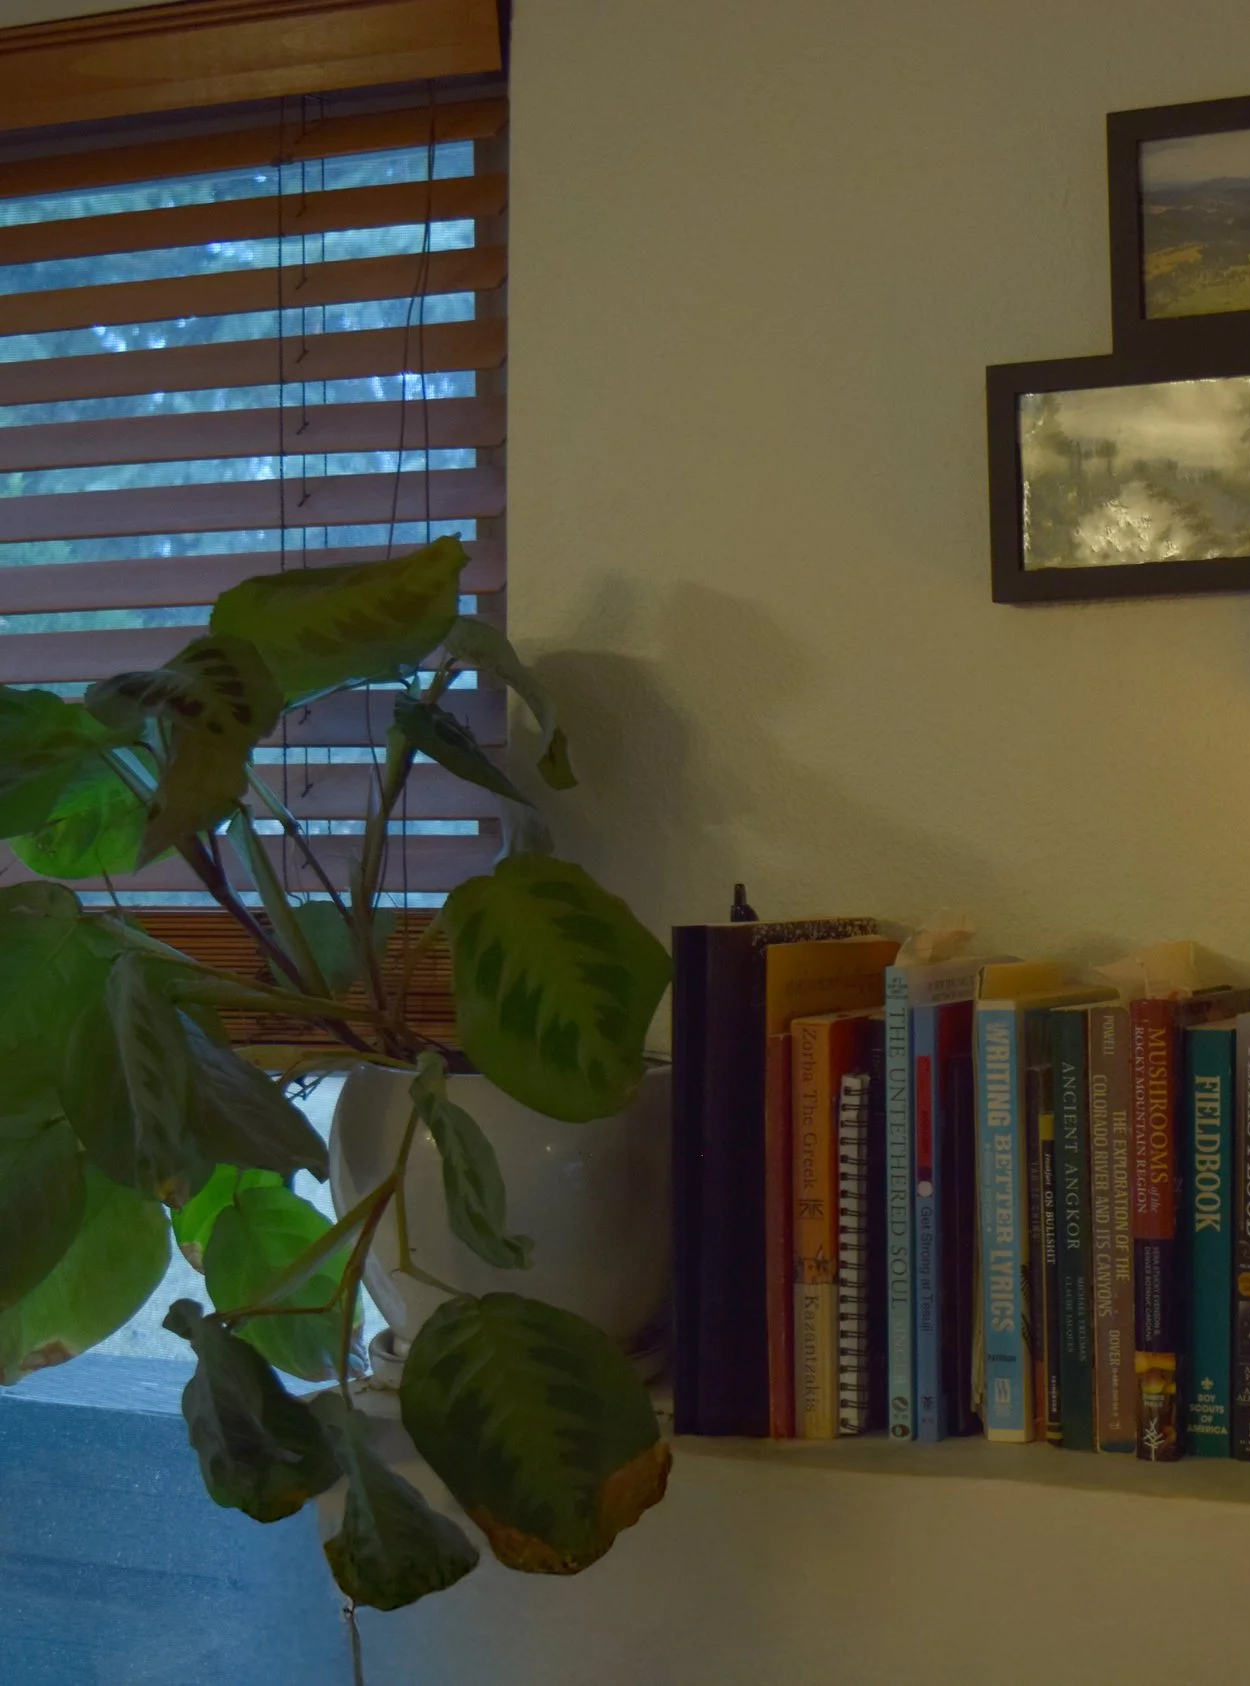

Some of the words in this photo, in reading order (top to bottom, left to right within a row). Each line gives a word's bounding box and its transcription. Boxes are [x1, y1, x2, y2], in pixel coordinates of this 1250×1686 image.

[889, 1007, 907, 1058] THE
[1102, 1015, 1116, 1056] POWELL
[1133, 1026, 1146, 1073] ROCKY
[802, 1027, 818, 1082] Zorba
[985, 1022, 1012, 1127] WRITING
[803, 1090, 819, 1126] The
[1061, 1061, 1079, 1154] ANCIENT
[1091, 1074, 1108, 1147] COLORADO
[1111, 1110, 1128, 1135] THE
[1134, 1076, 1147, 1158] MOUNTAIN
[1147, 1027, 1169, 1184] MUSHROOMS
[803, 1132, 819, 1190] Greek
[889, 1068, 908, 1236] UNTETHERED
[1094, 1150, 1111, 1190] RIVER
[1194, 1075, 1222, 1233] FIELDBOOK
[994, 1134, 1014, 1244] BETTER
[1044, 1190, 1055, 1207] ON
[1063, 1163, 1080, 1250] ANGKOR
[1112, 1140, 1129, 1231] EXPLORATION
[1135, 1159, 1149, 1214] REGION
[1147, 1186, 1161, 1196] of
[1150, 1198, 1162, 1214] the
[920, 1206, 934, 1230] Get
[1095, 1196, 1111, 1224] AND
[916, 1232, 934, 1274] Strong
[1045, 1210, 1057, 1265] BULLSHIT
[1095, 1229, 1111, 1249] ITS
[1115, 1234, 1130, 1254] OF
[890, 1245, 909, 1310] SOUL
[920, 1279, 933, 1291] at
[1096, 1252, 1113, 1318] CANYONS
[1115, 1256, 1130, 1282] THE
[989, 1248, 1016, 1333] LYRICS
[1077, 1276, 1087, 1316] MICHAEL
[917, 1294, 935, 1332] Tesuji
[804, 1295, 821, 1413] Kazantzakis
[1079, 1319, 1089, 1362] FREEMAN
[1108, 1329, 1121, 1366] DOVER
[1189, 1403, 1225, 1414] SCOUTS
[1197, 1393, 1216, 1403] BOY
[1200, 1414, 1214, 1424] OF
[1186, 1423, 1230, 1435] AMERICA
